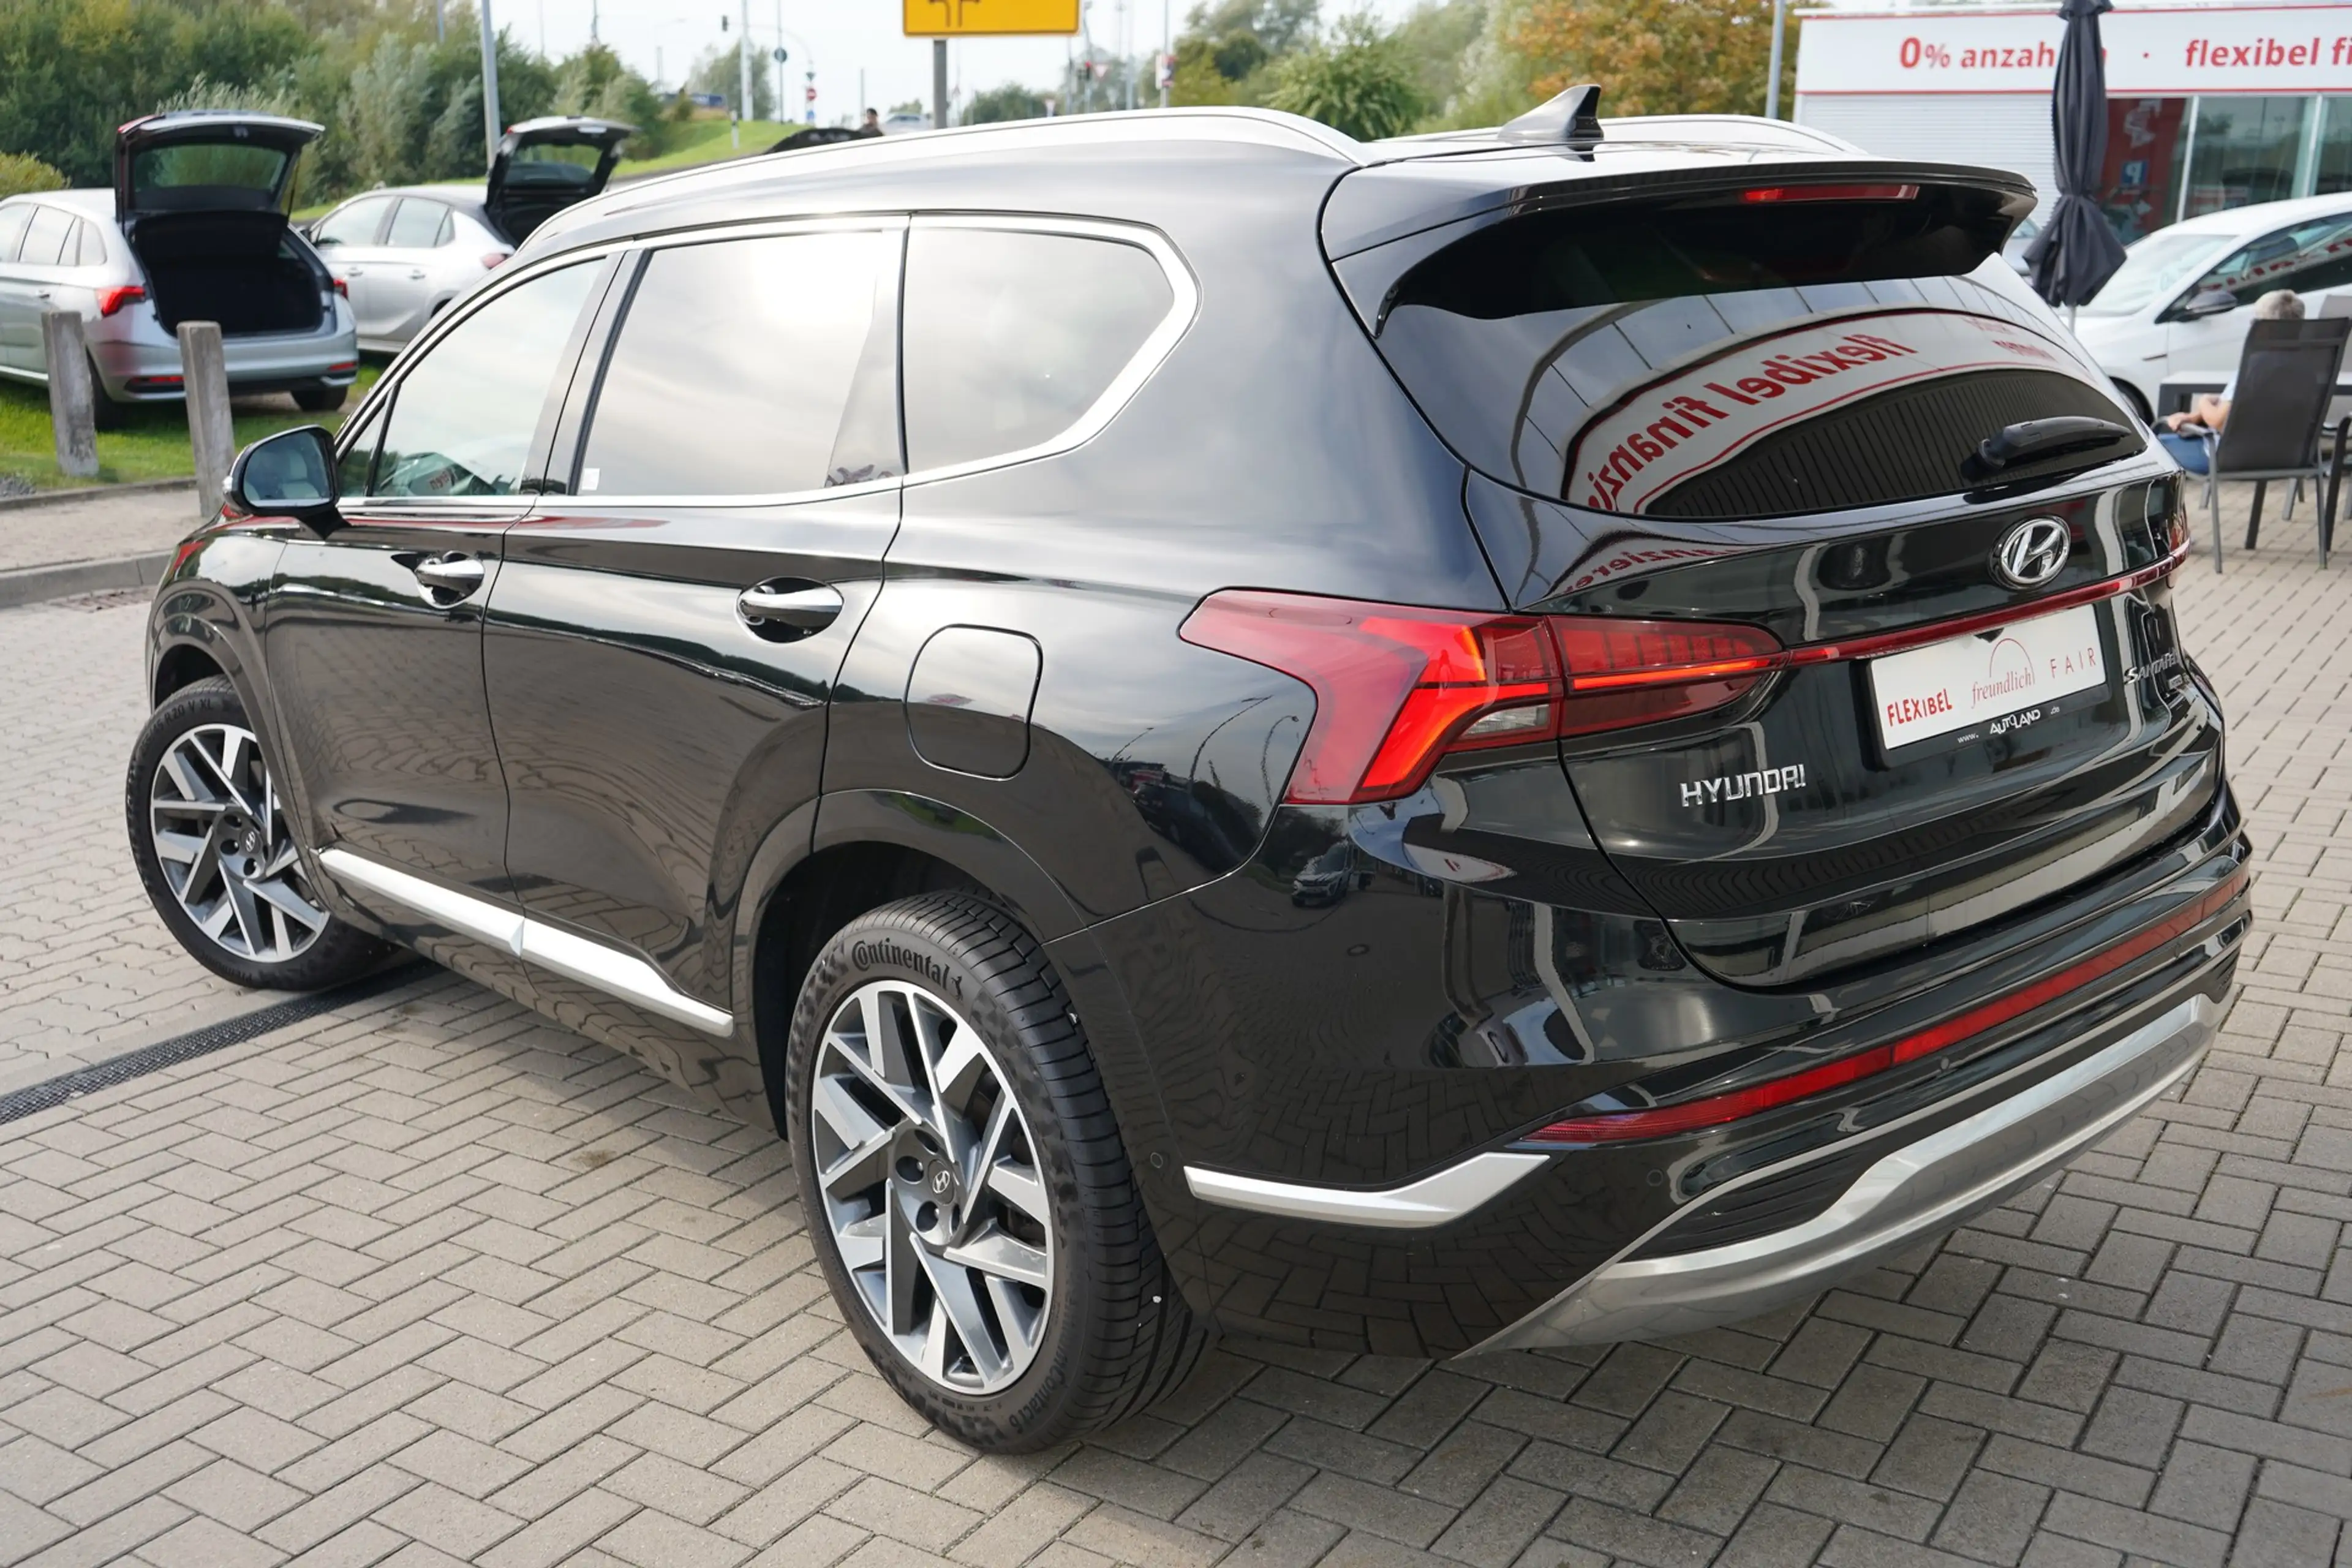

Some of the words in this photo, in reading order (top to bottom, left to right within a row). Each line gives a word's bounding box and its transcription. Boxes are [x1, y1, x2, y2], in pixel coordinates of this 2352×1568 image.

[1899, 37, 1951, 69] 0%
[2185, 37, 2320, 67] flexibel
[1887, 688, 1953, 727] FLEXIBEL
[1970, 666, 2032, 709] freundlich
[1989, 709, 2041, 735] AUTOLAND
[1679, 763, 1806, 807] HYUNDAI
[851, 937, 950, 991] Continental
